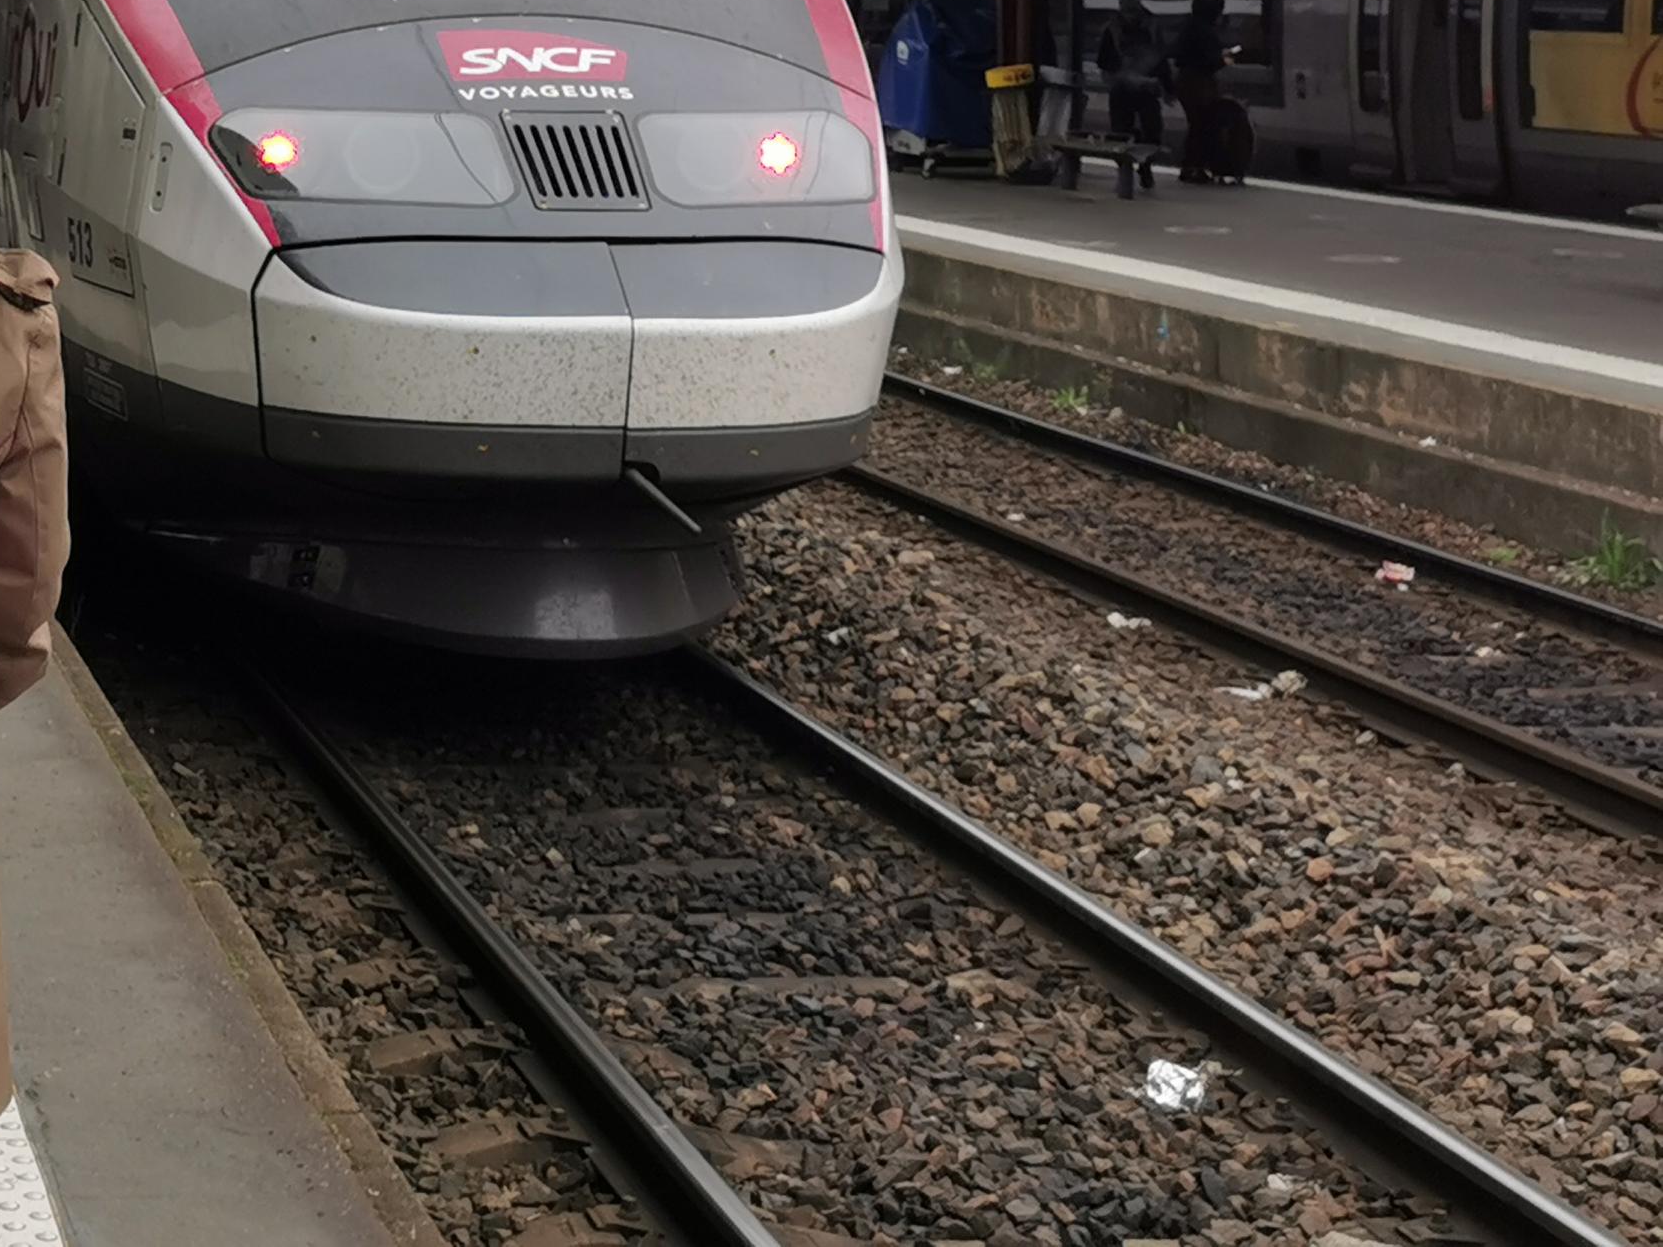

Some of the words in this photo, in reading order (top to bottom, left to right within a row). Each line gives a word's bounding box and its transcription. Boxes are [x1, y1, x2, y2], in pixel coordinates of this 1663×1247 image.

[459, 47, 617, 75] SNCF
[457, 84, 634, 101] VOYAGEURS
[67, 217, 93, 268] 513
